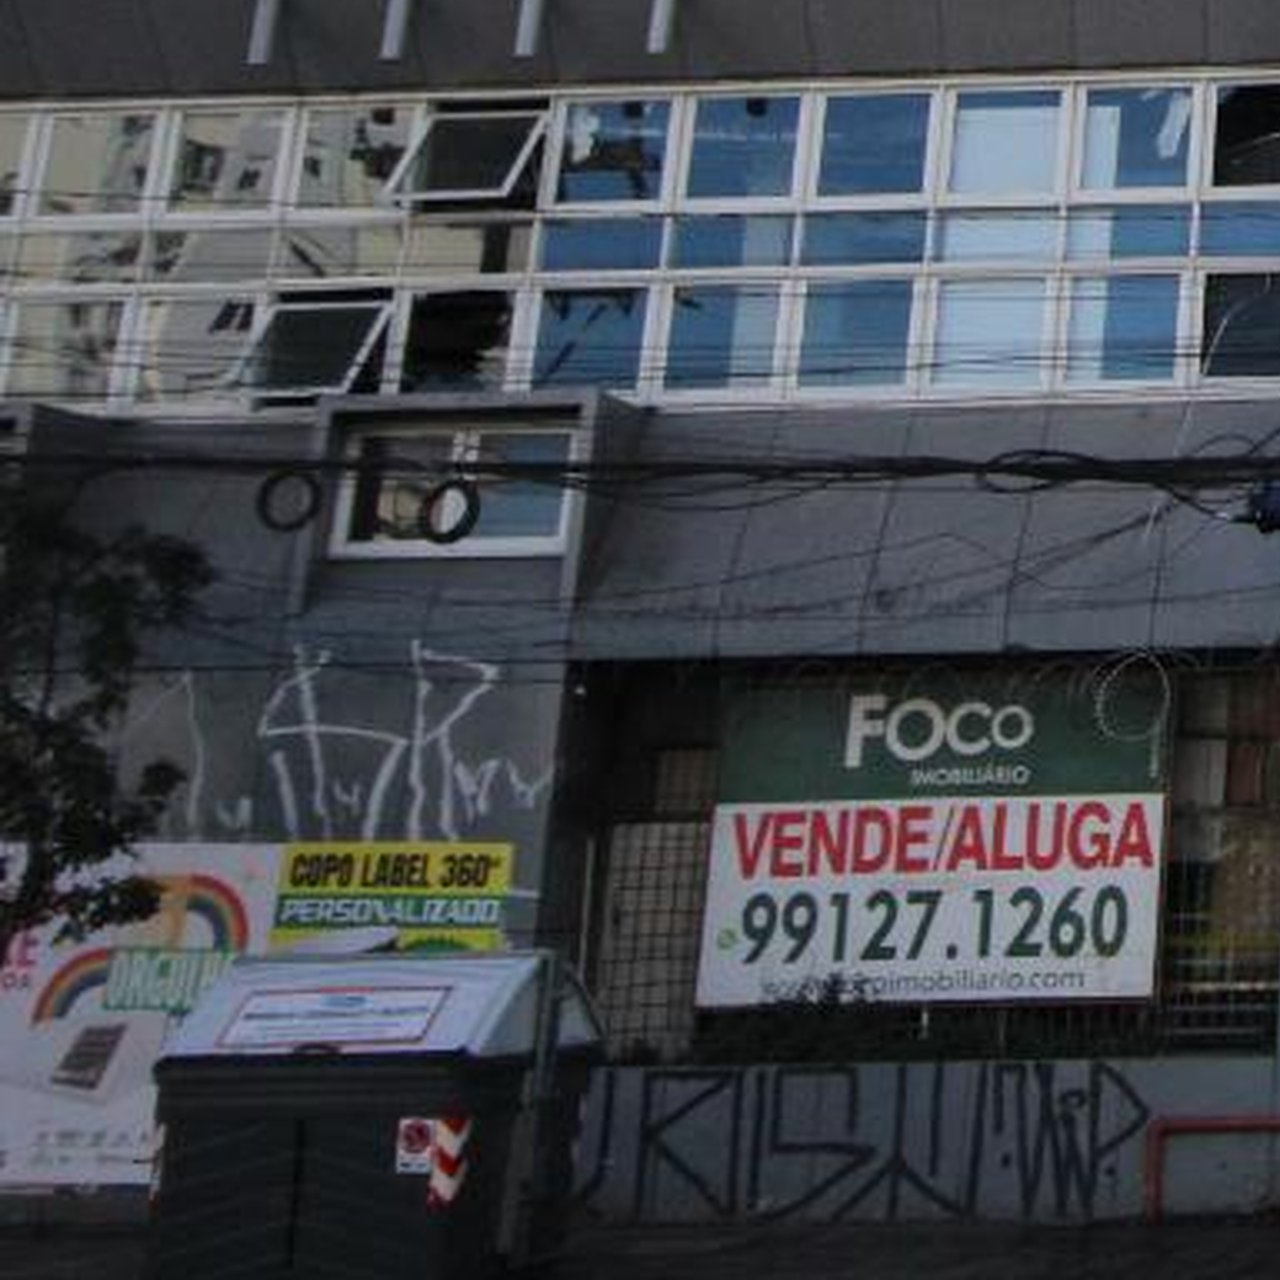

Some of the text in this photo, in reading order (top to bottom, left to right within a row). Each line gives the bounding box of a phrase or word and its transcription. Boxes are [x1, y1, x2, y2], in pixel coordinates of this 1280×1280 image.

[289, 851, 355, 888] COPO
[360, 851, 430, 888] LABEL
[732, 800, 1155, 881] VENDE/ALUGA
[741, 884, 1129, 965] 99127.1260
